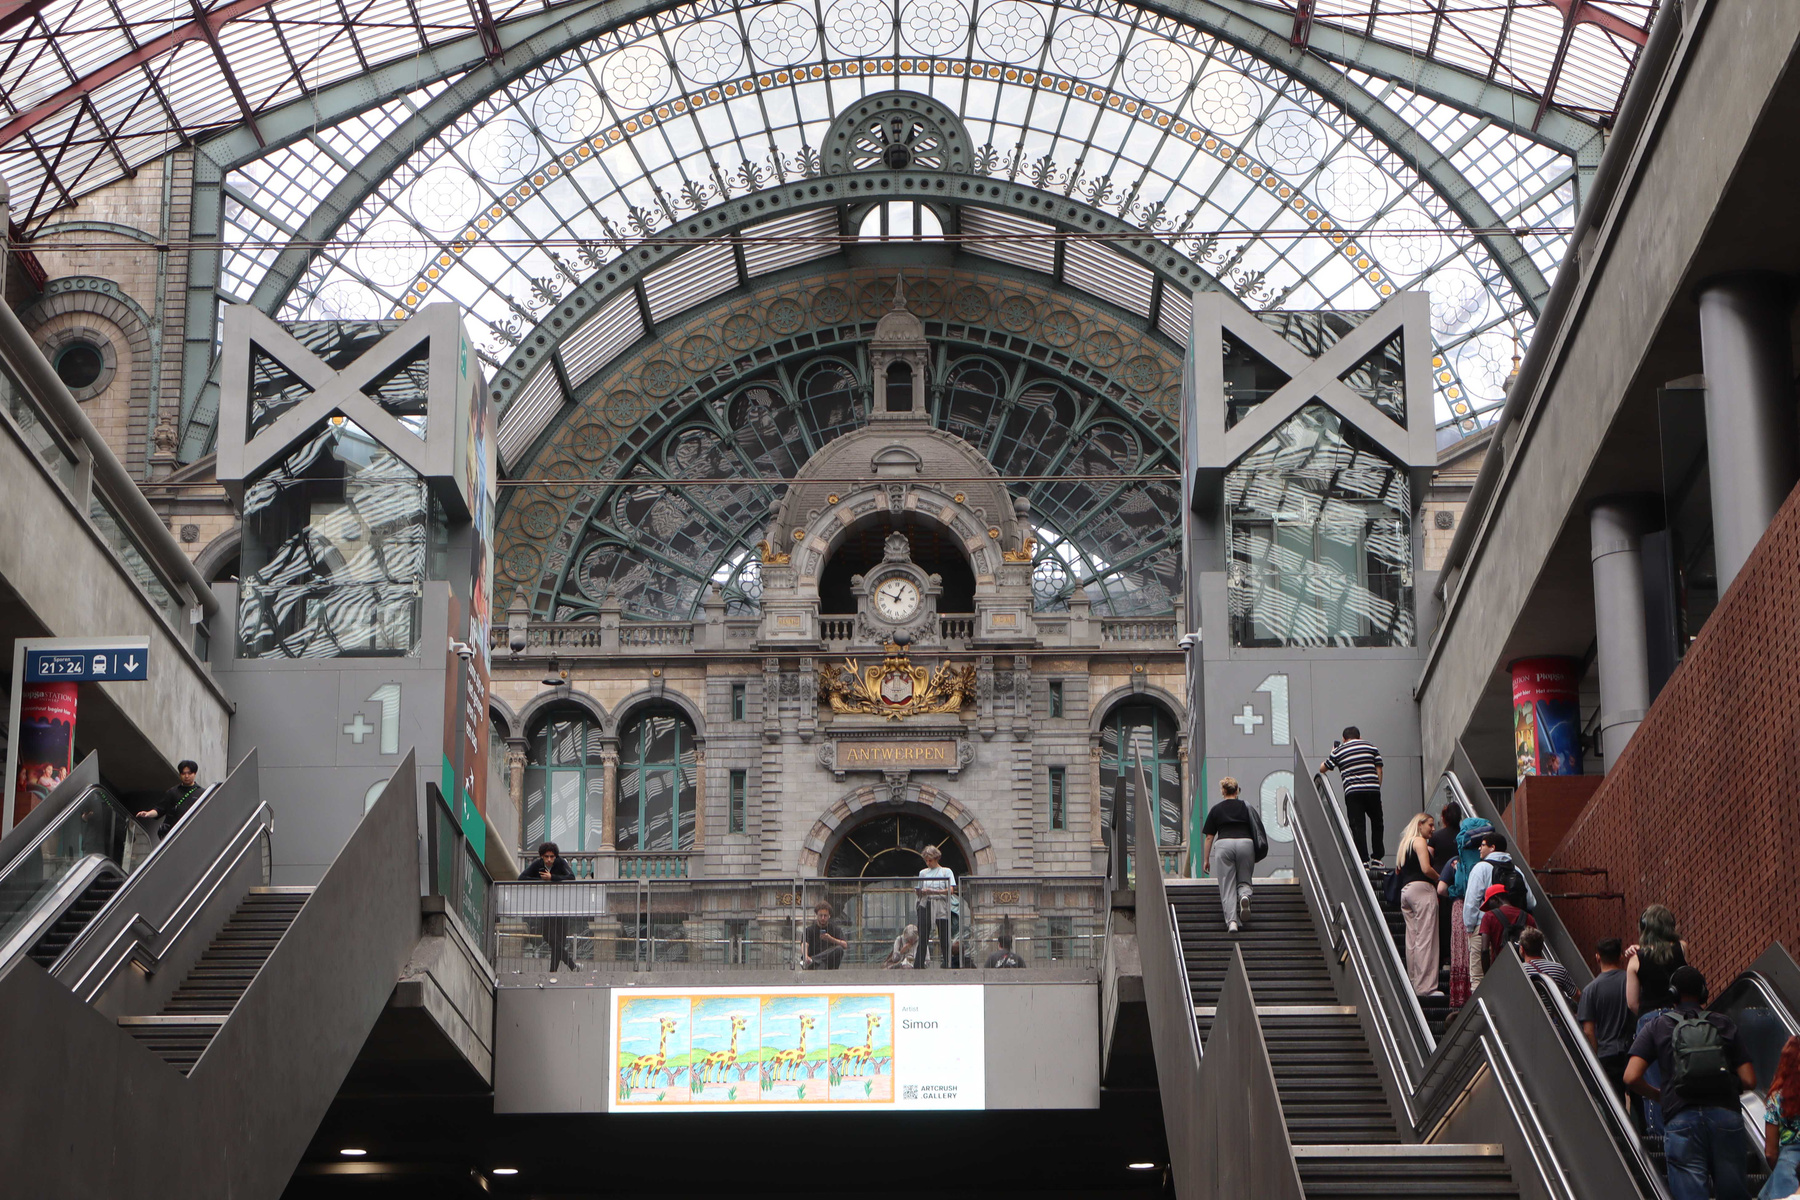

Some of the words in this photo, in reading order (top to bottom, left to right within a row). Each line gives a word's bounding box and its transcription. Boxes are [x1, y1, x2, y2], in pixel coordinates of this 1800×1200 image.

[41, 662, 54, 674] 21
[67, 662, 82, 673] 24
[847, 747, 945, 761] ANTWERPEN
[902, 1019, 938, 1029] Simon
